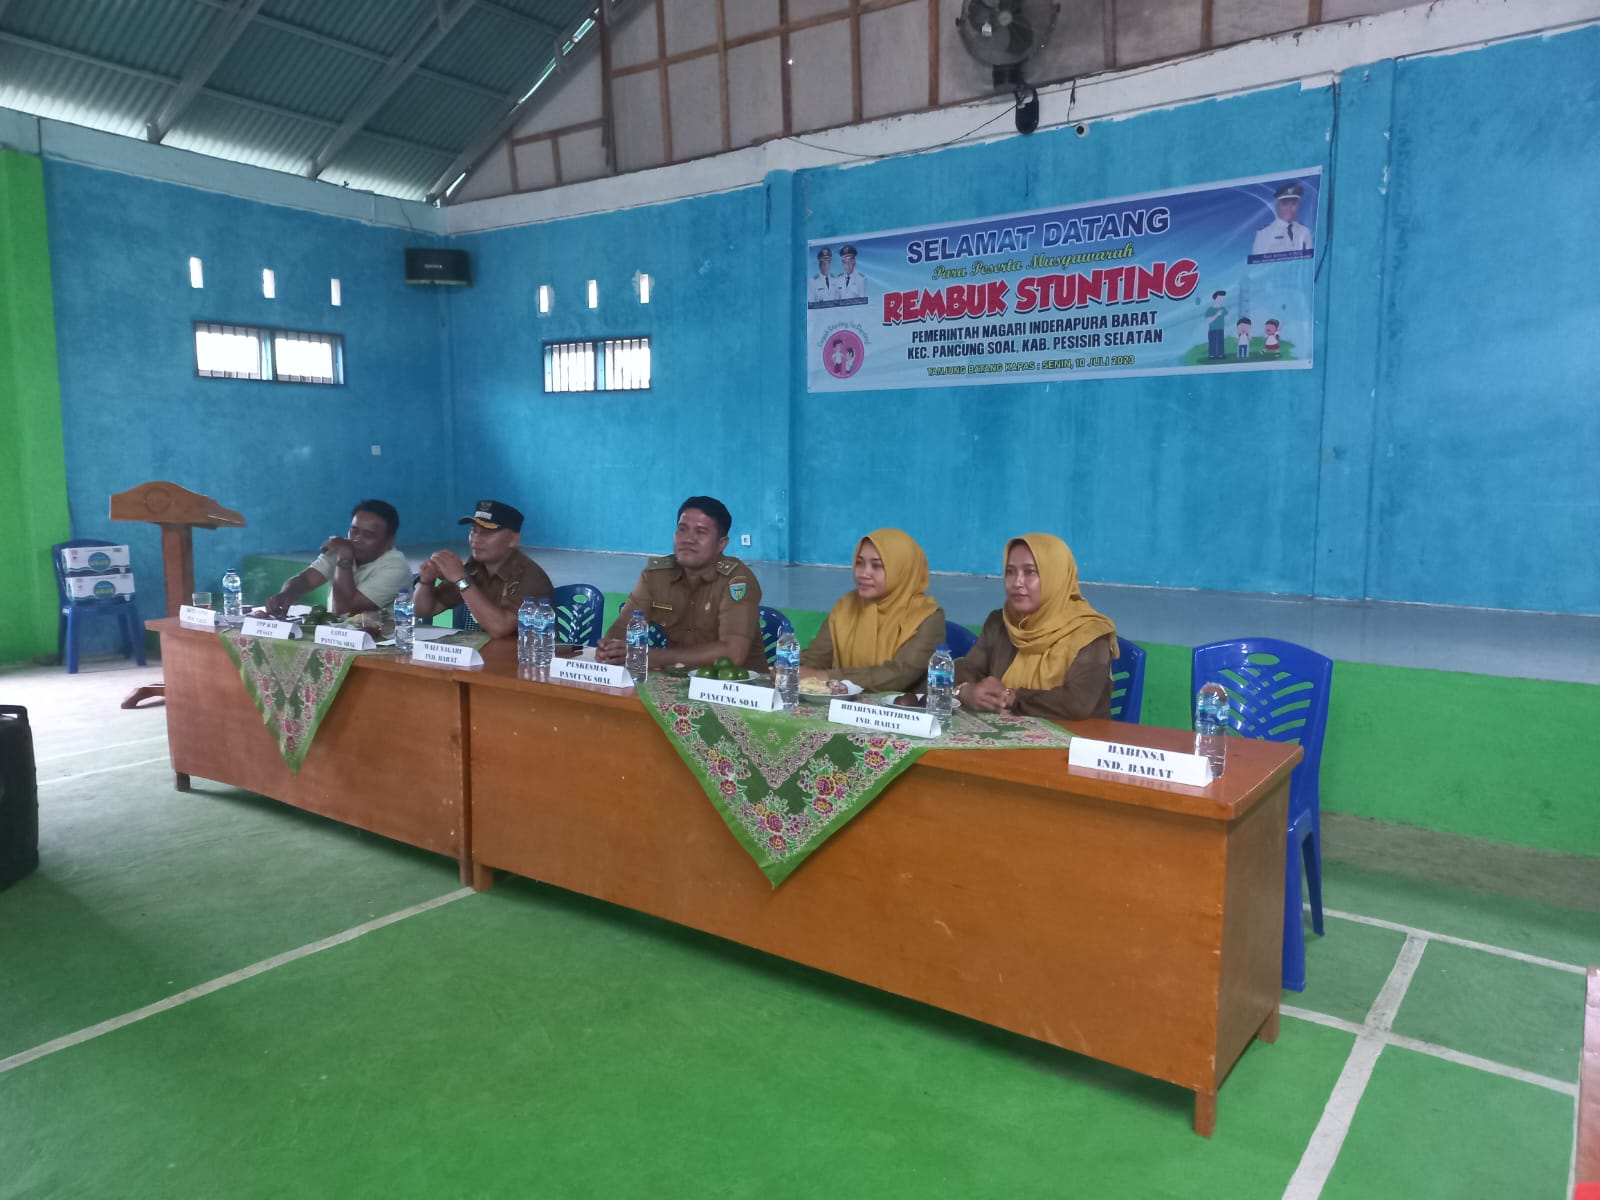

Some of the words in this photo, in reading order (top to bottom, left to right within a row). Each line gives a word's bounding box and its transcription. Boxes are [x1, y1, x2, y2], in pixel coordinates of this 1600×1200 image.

[907, 226, 1035, 264] SELAMAT
[1042, 207, 1170, 248] DATANG
[932, 264, 967, 280] Para
[883, 280, 1009, 325] REMBUK
[1014, 258, 1199, 314] STUNTING
[912, 326, 979, 343] PEMERINTAH
[982, 322, 1026, 338] NAGARI
[1030, 315, 1107, 334] INDERAPURA
[1112, 311, 1157, 327] BARAT
[907, 347, 930, 359] KEC.
[933, 342, 984, 358] PANCUNG
[988, 340, 1019, 354] SOAL,
[1022, 337, 1050, 353] KAB.
[1053, 333, 1100, 350] PESISIR
[1104, 329, 1163, 346] SELATAN
[927, 366, 966, 376] TANJUNG
[968, 364, 1003, 375] BATANG
[1005, 361, 1035, 373] KAPAS
[1042, 358, 1073, 370] SENIN,
[1075, 358, 1086, 368] 10
[1087, 356, 1110, 367] JULI
[1111, 354, 1135, 366] 2023
[566, 661, 608, 672] PUSKESMAS
[559, 670, 593, 682] PANCUNG
[594, 675, 611, 685] SOAL
[722, 683, 740, 692] KUA
[700, 692, 737, 704] PANCUNG
[737, 697, 759, 708] SOAL
[841, 703, 920, 721] BHABINKAMTIBMAS
[855, 716, 871, 725] IND.
[874, 720, 900, 730] BARAT
[1108, 744, 1166, 761] BABINSA
[1097, 758, 1123, 771] IND.
[1128, 763, 1174, 779] BARAT
